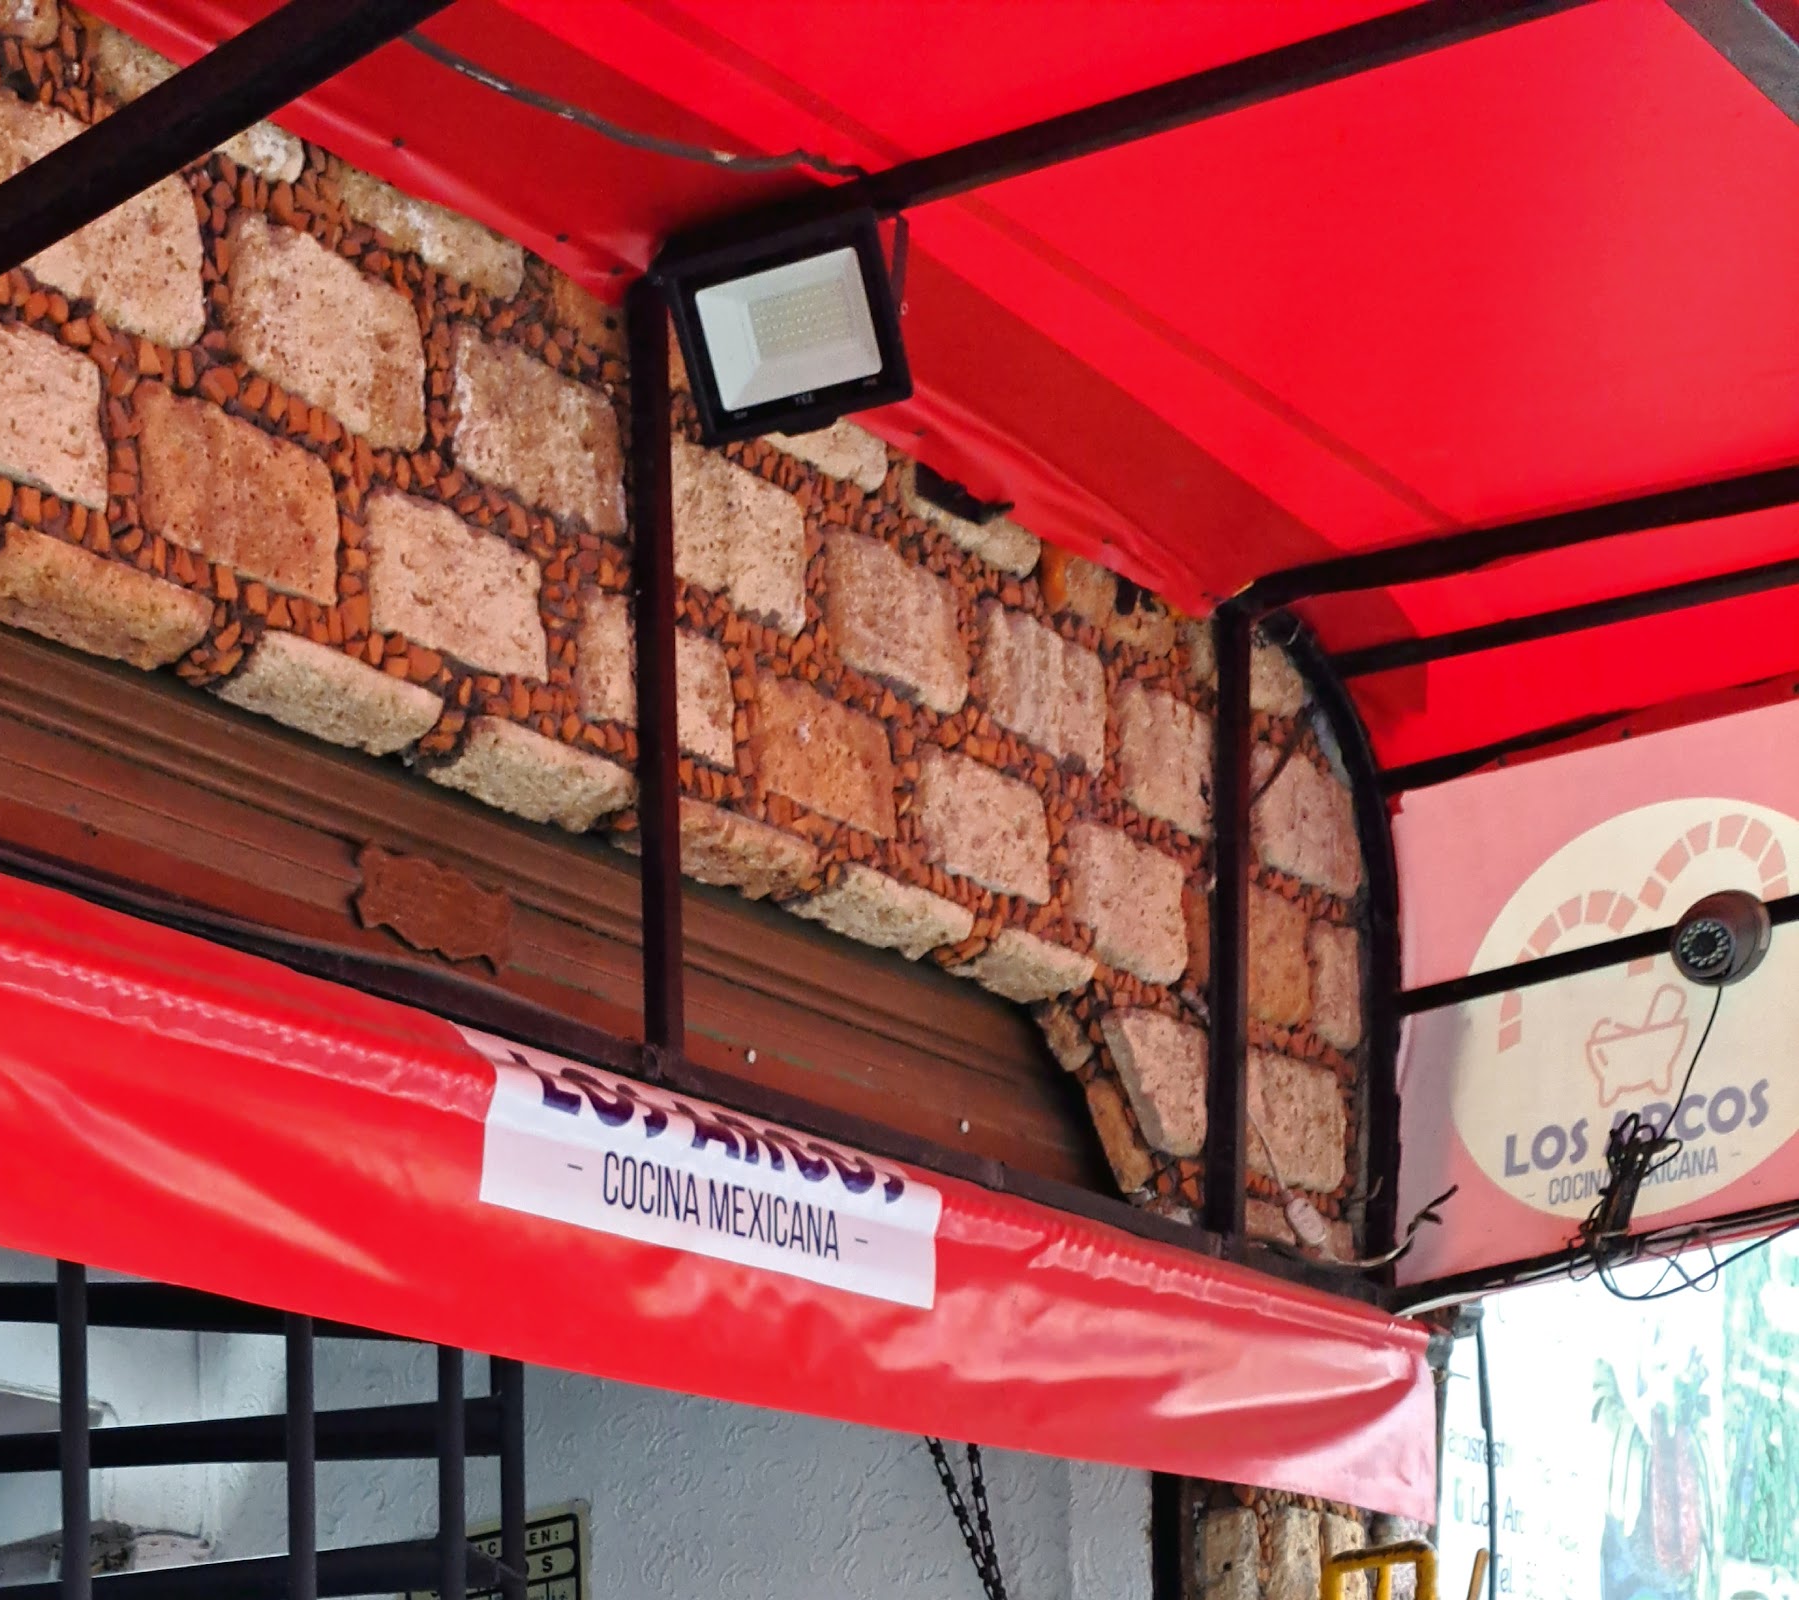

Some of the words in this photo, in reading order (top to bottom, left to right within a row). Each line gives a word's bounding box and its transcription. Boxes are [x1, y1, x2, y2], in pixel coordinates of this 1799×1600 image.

[1504, 1117, 1588, 1178] LOS
[602, 1150, 699, 1226] COCINA
[708, 1180, 840, 1262] MEXICANA
